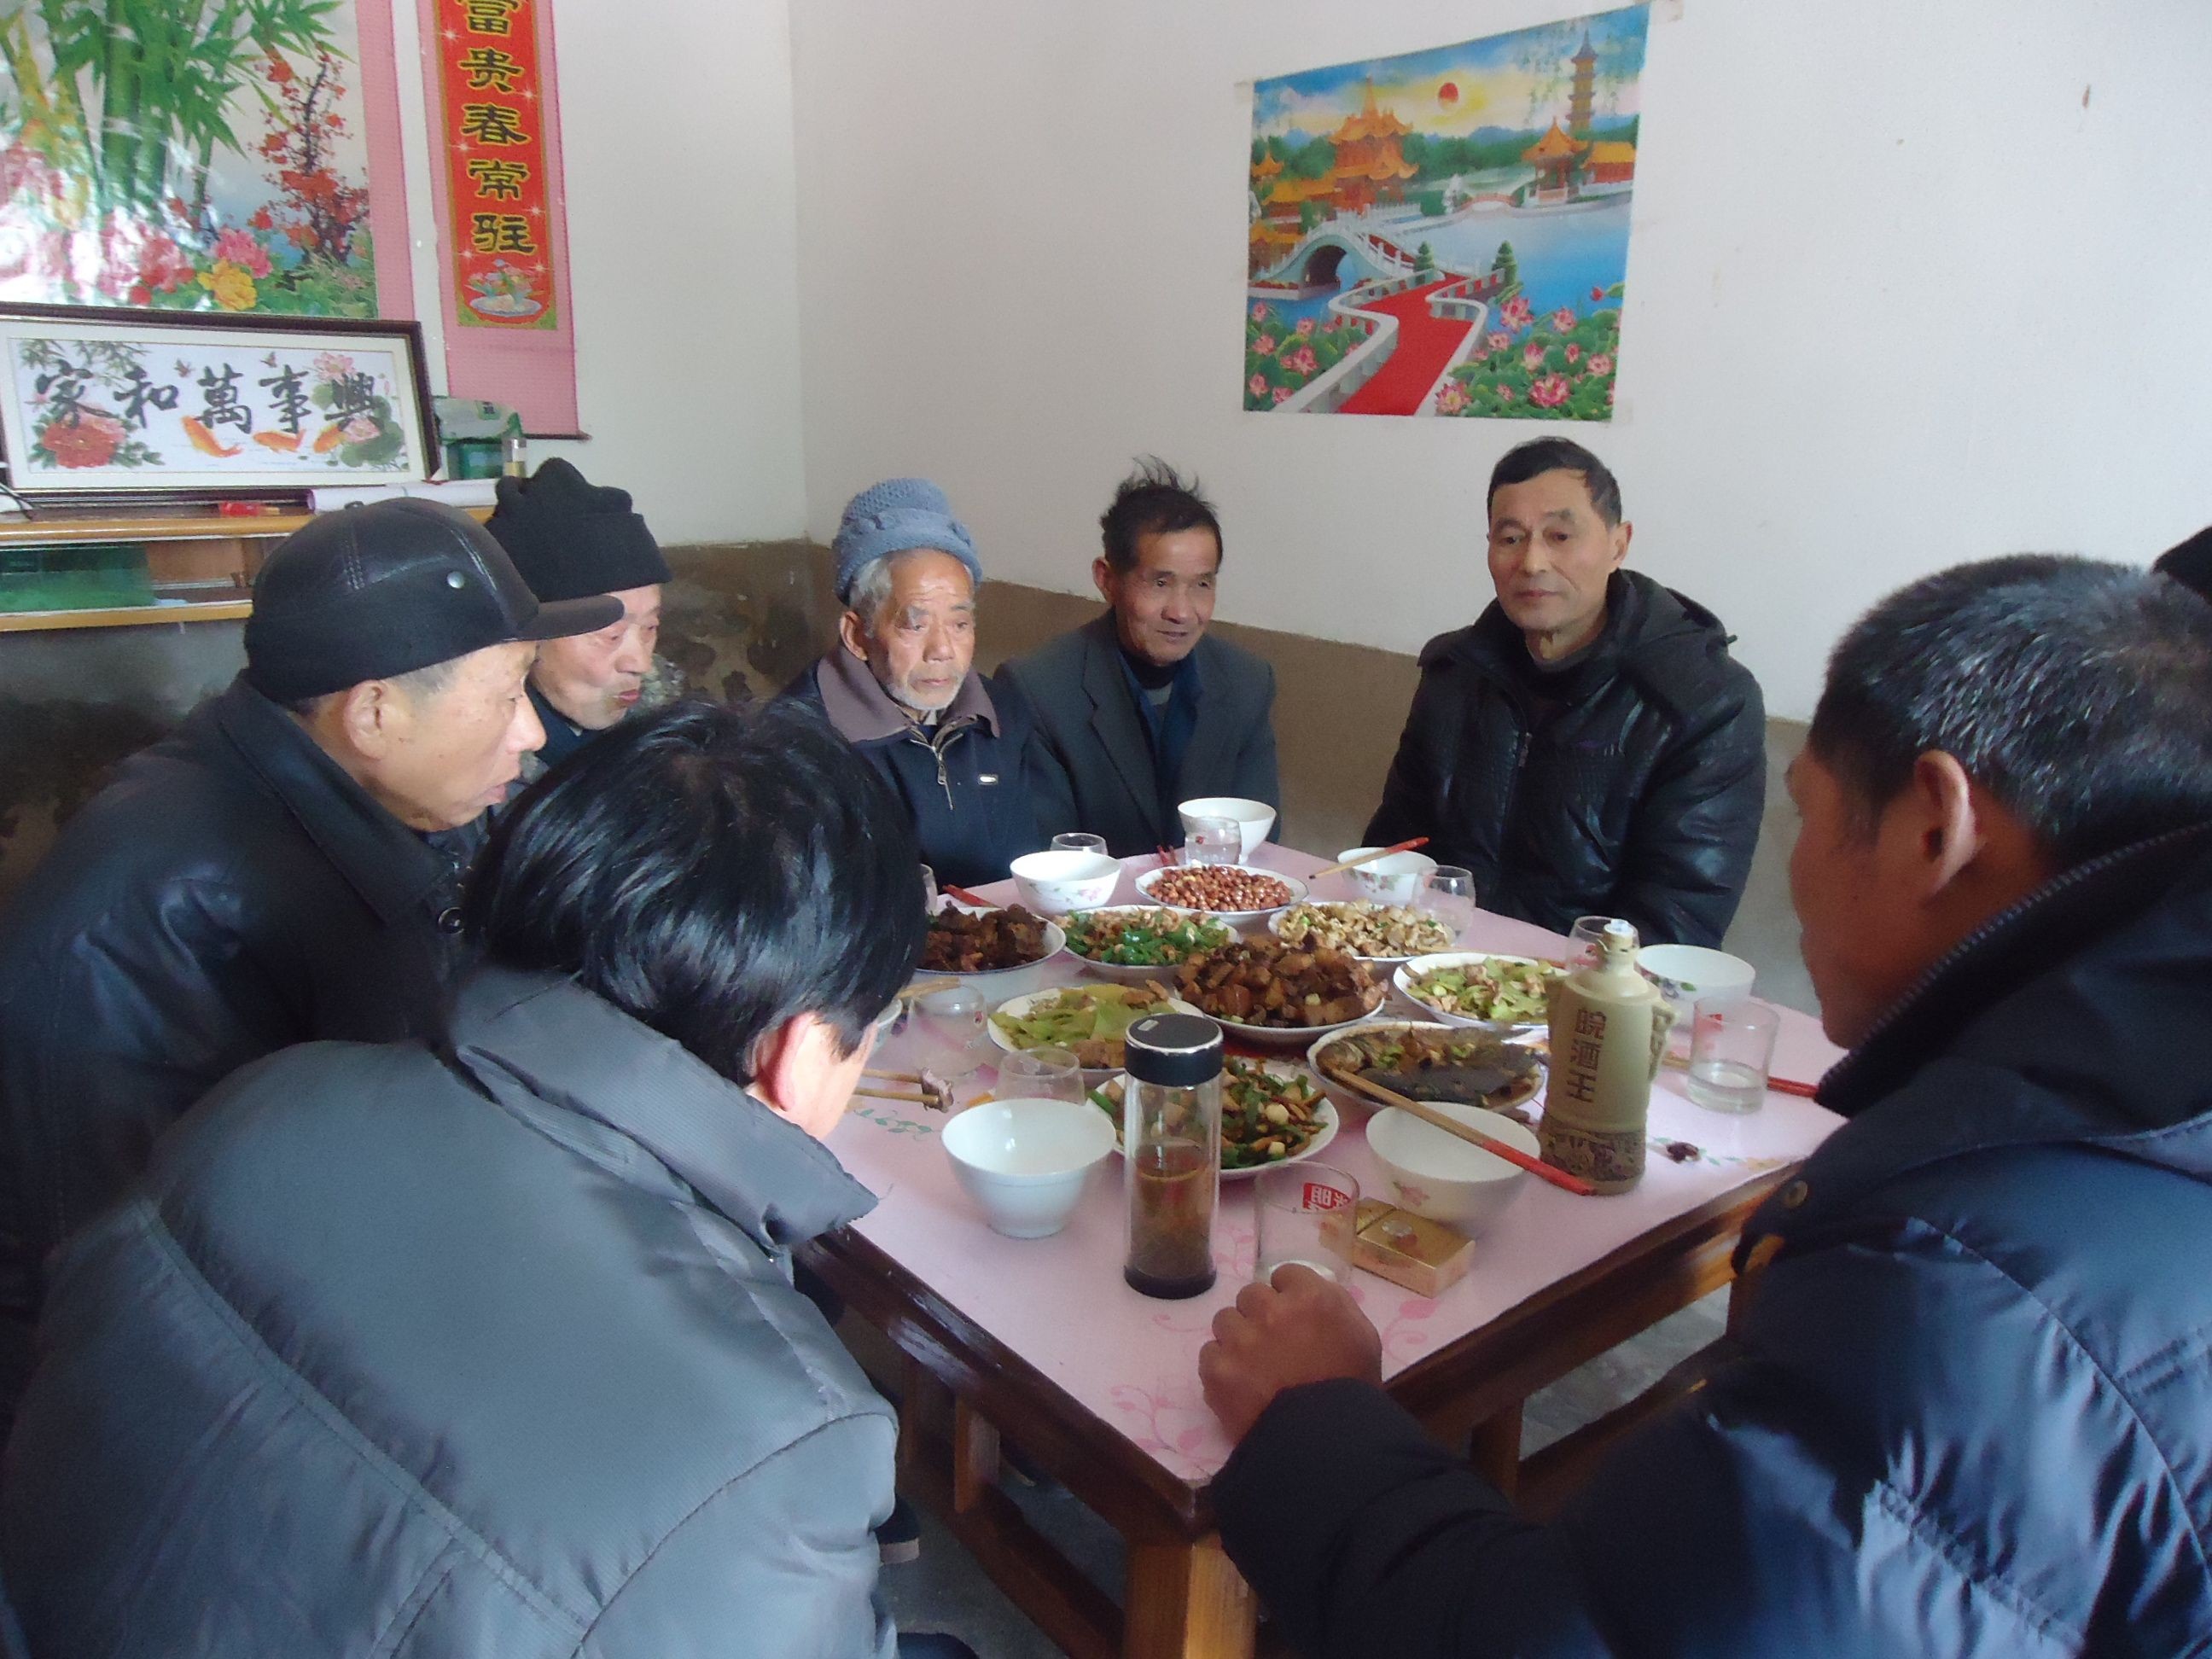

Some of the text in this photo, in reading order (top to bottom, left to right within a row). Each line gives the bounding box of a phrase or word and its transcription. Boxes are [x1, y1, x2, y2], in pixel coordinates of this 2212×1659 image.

[457, 0, 536, 254] 富贵春常驻
[35, 358, 385, 435] 家和萬事興
